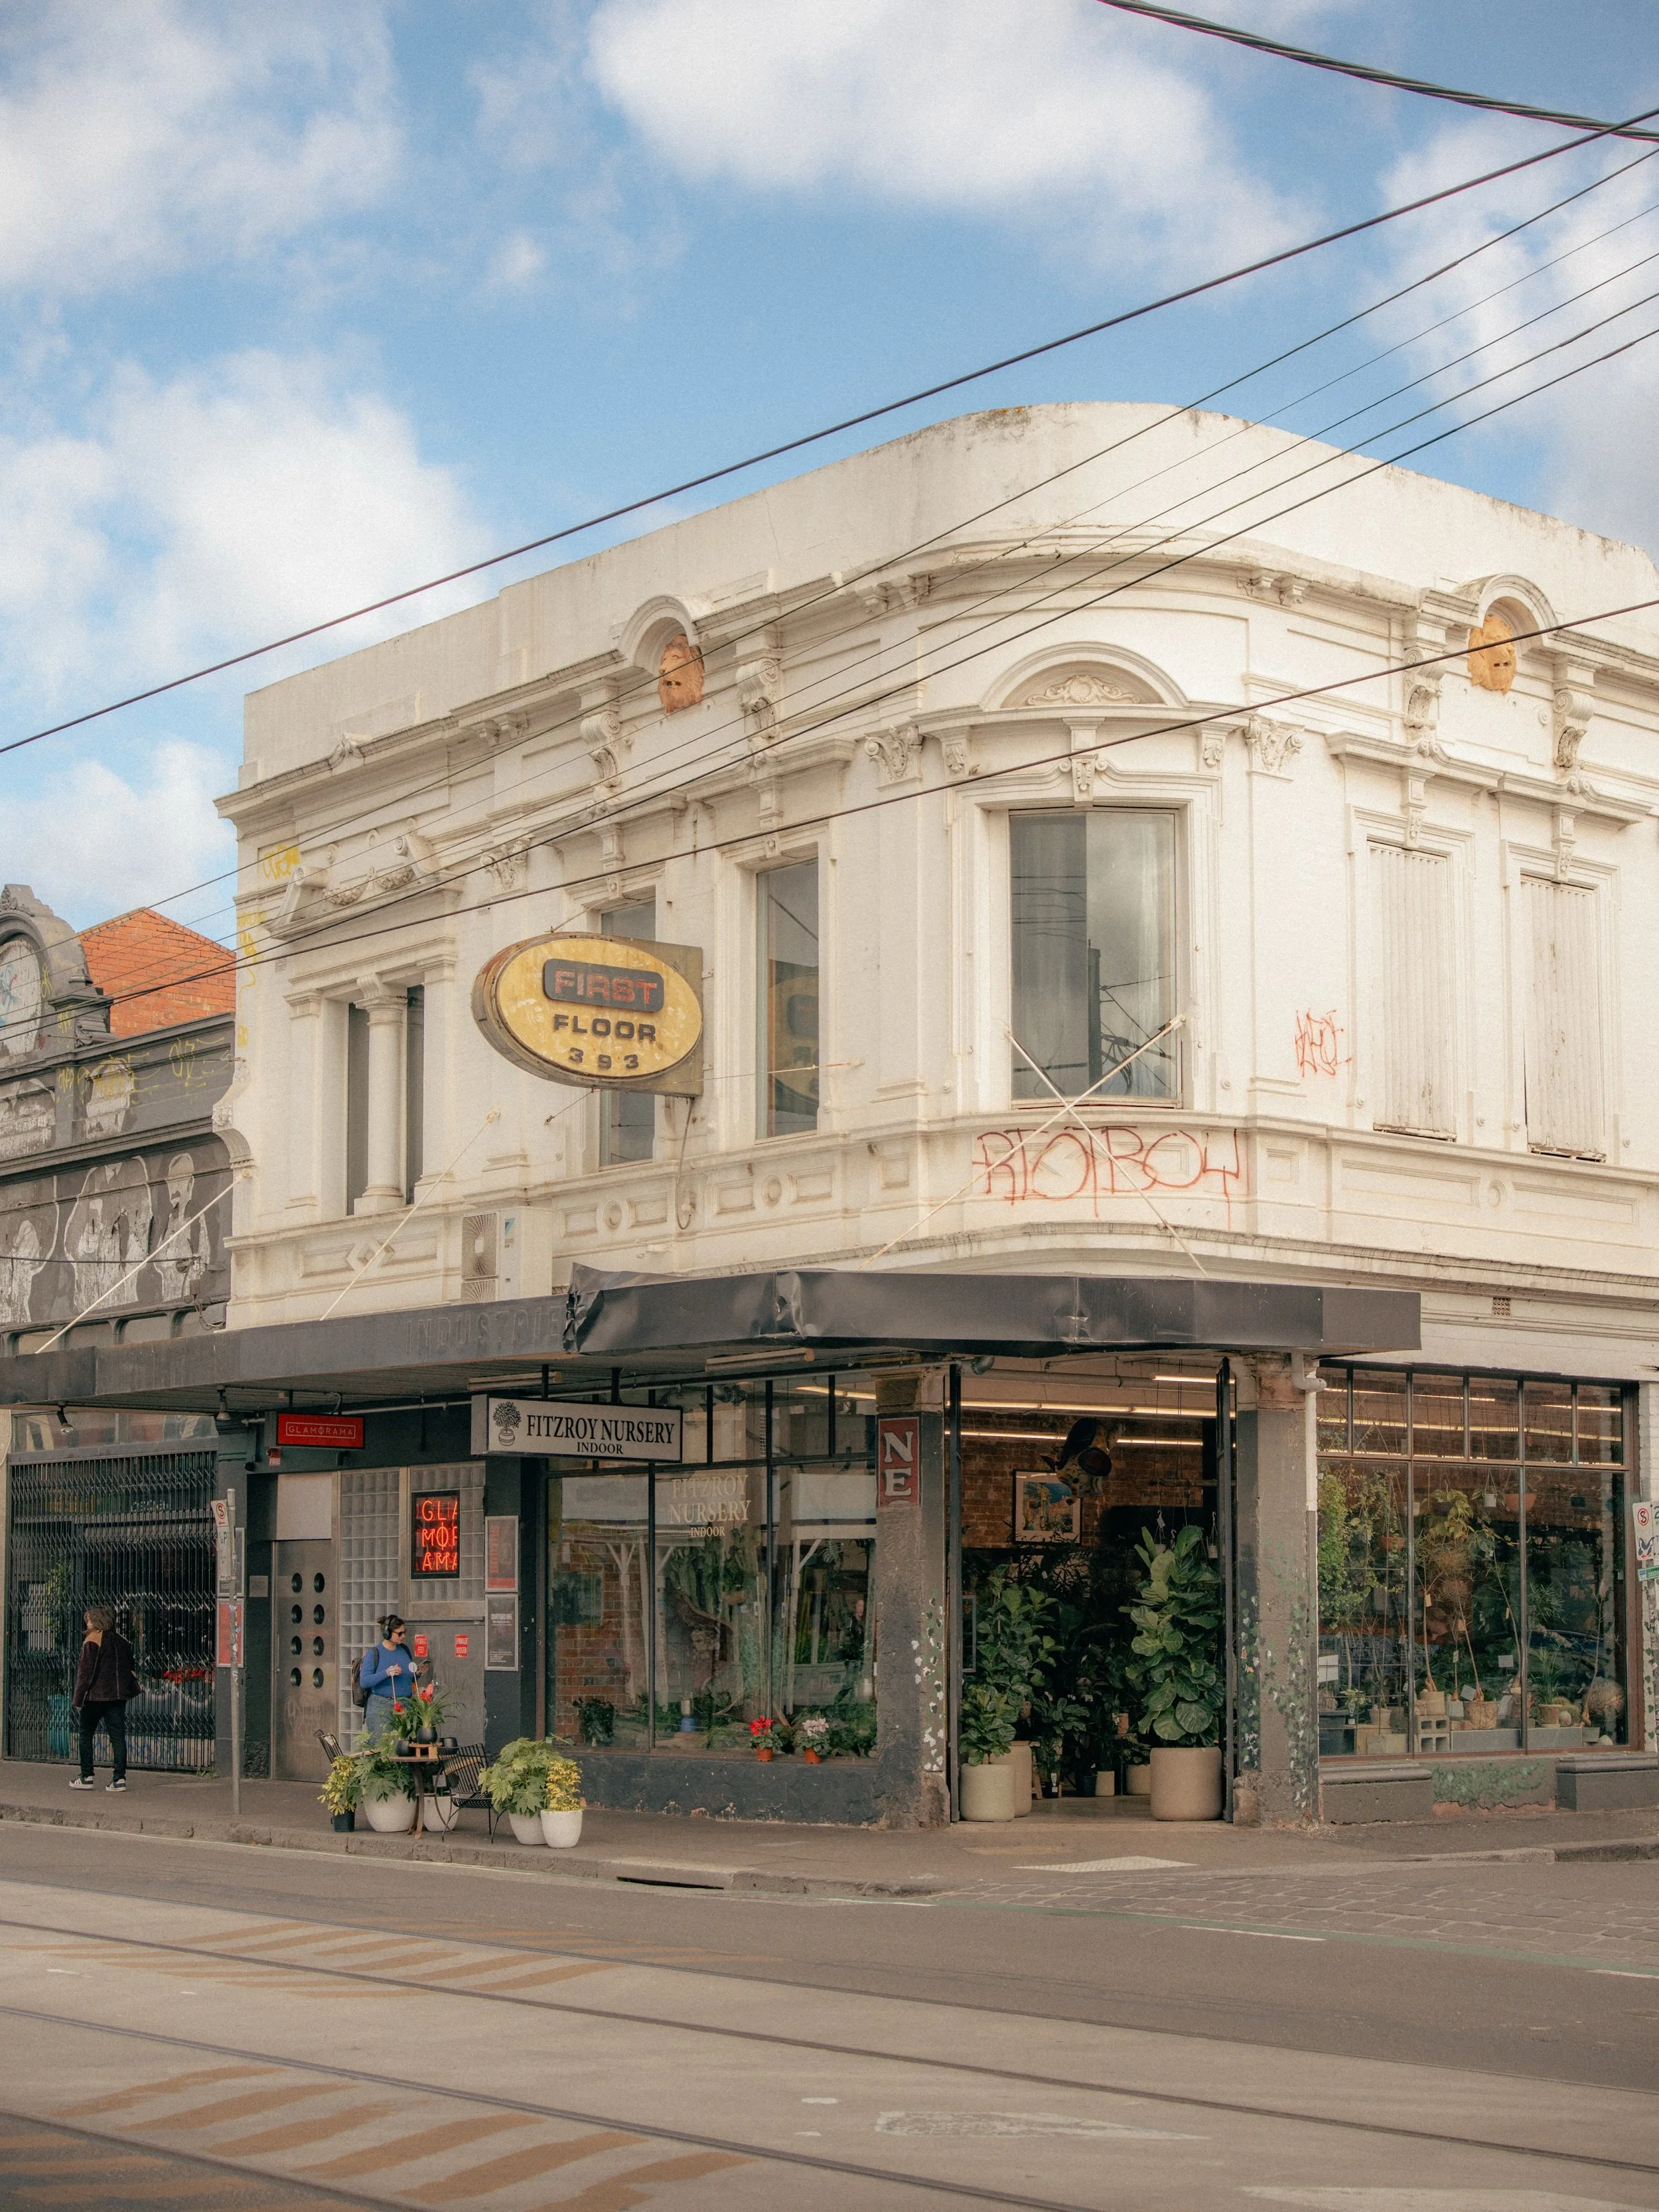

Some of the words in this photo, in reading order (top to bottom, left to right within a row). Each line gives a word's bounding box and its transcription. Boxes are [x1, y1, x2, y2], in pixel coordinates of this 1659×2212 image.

[553, 969, 658, 1005] FIRST
[553, 1013, 656, 1043] FLOOR
[568, 1047, 639, 1070] 393
[526, 1414, 598, 1439] FITZROY
[601, 1418, 675, 1444] NURSERY
[576, 1441, 624, 1455] INDOOR
[672, 1474, 749, 1499] FITZROY
[670, 1500, 751, 1524] NURSERY
[691, 1526, 725, 1538] INDOOR
